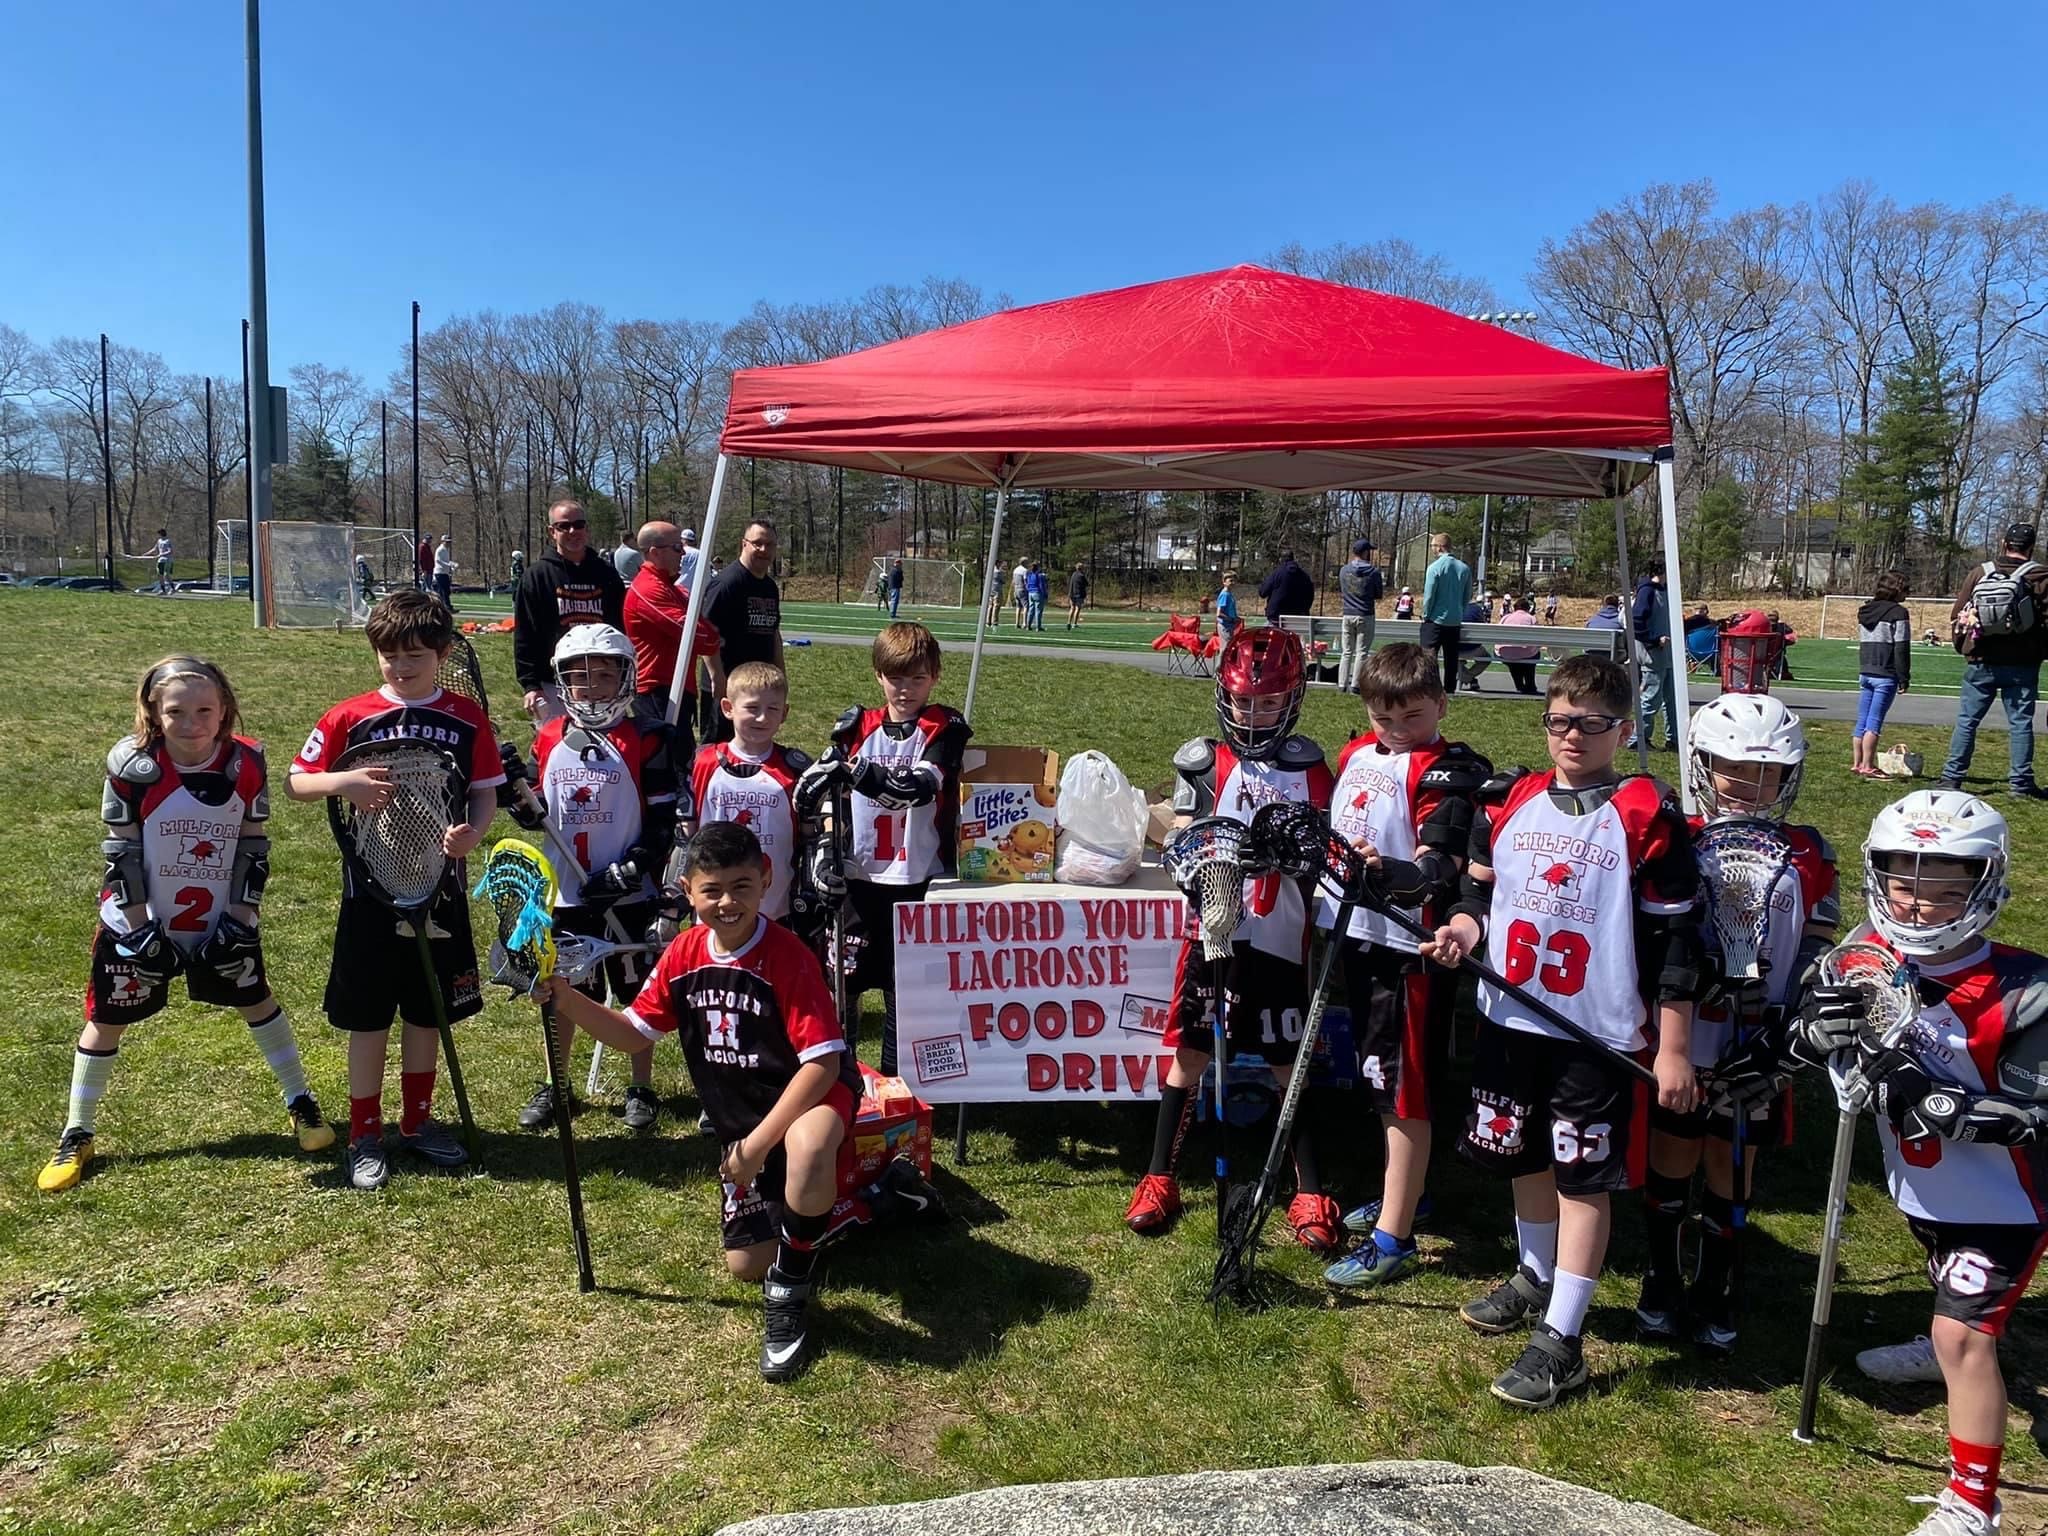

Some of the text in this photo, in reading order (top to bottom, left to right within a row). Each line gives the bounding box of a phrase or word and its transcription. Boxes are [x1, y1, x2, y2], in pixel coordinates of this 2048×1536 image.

[557, 597, 604, 616] BASEBALL
[370, 724, 460, 745] MILFORD
[550, 768, 621, 785] MILFORD
[974, 788, 1015, 819] Little
[561, 812, 614, 825] ACROSSE
[986, 806, 1029, 830] Bites
[1513, 832, 1620, 871] MILFORD
[160, 865, 234, 881] LACROSSE
[168, 885, 215, 932] 2
[897, 901, 1064, 944] MILFORD
[947, 944, 1129, 992] LACROSSE
[1504, 918, 1592, 997] 63
[968, 1000, 1105, 1041] FOOD
[1141, 1006, 1169, 1030] M
[1260, 1007, 1304, 1043] 10
[703, 1046, 759, 1069] LACOSE
[925, 1041, 951, 1051] DAILY
[926, 1048, 956, 1059] BREAD
[927, 1056, 953, 1067] FOOD
[929, 1062, 962, 1074] PANTRY
[1552, 1119, 1612, 1164] 63
[769, 1285, 792, 1298] NIKE
